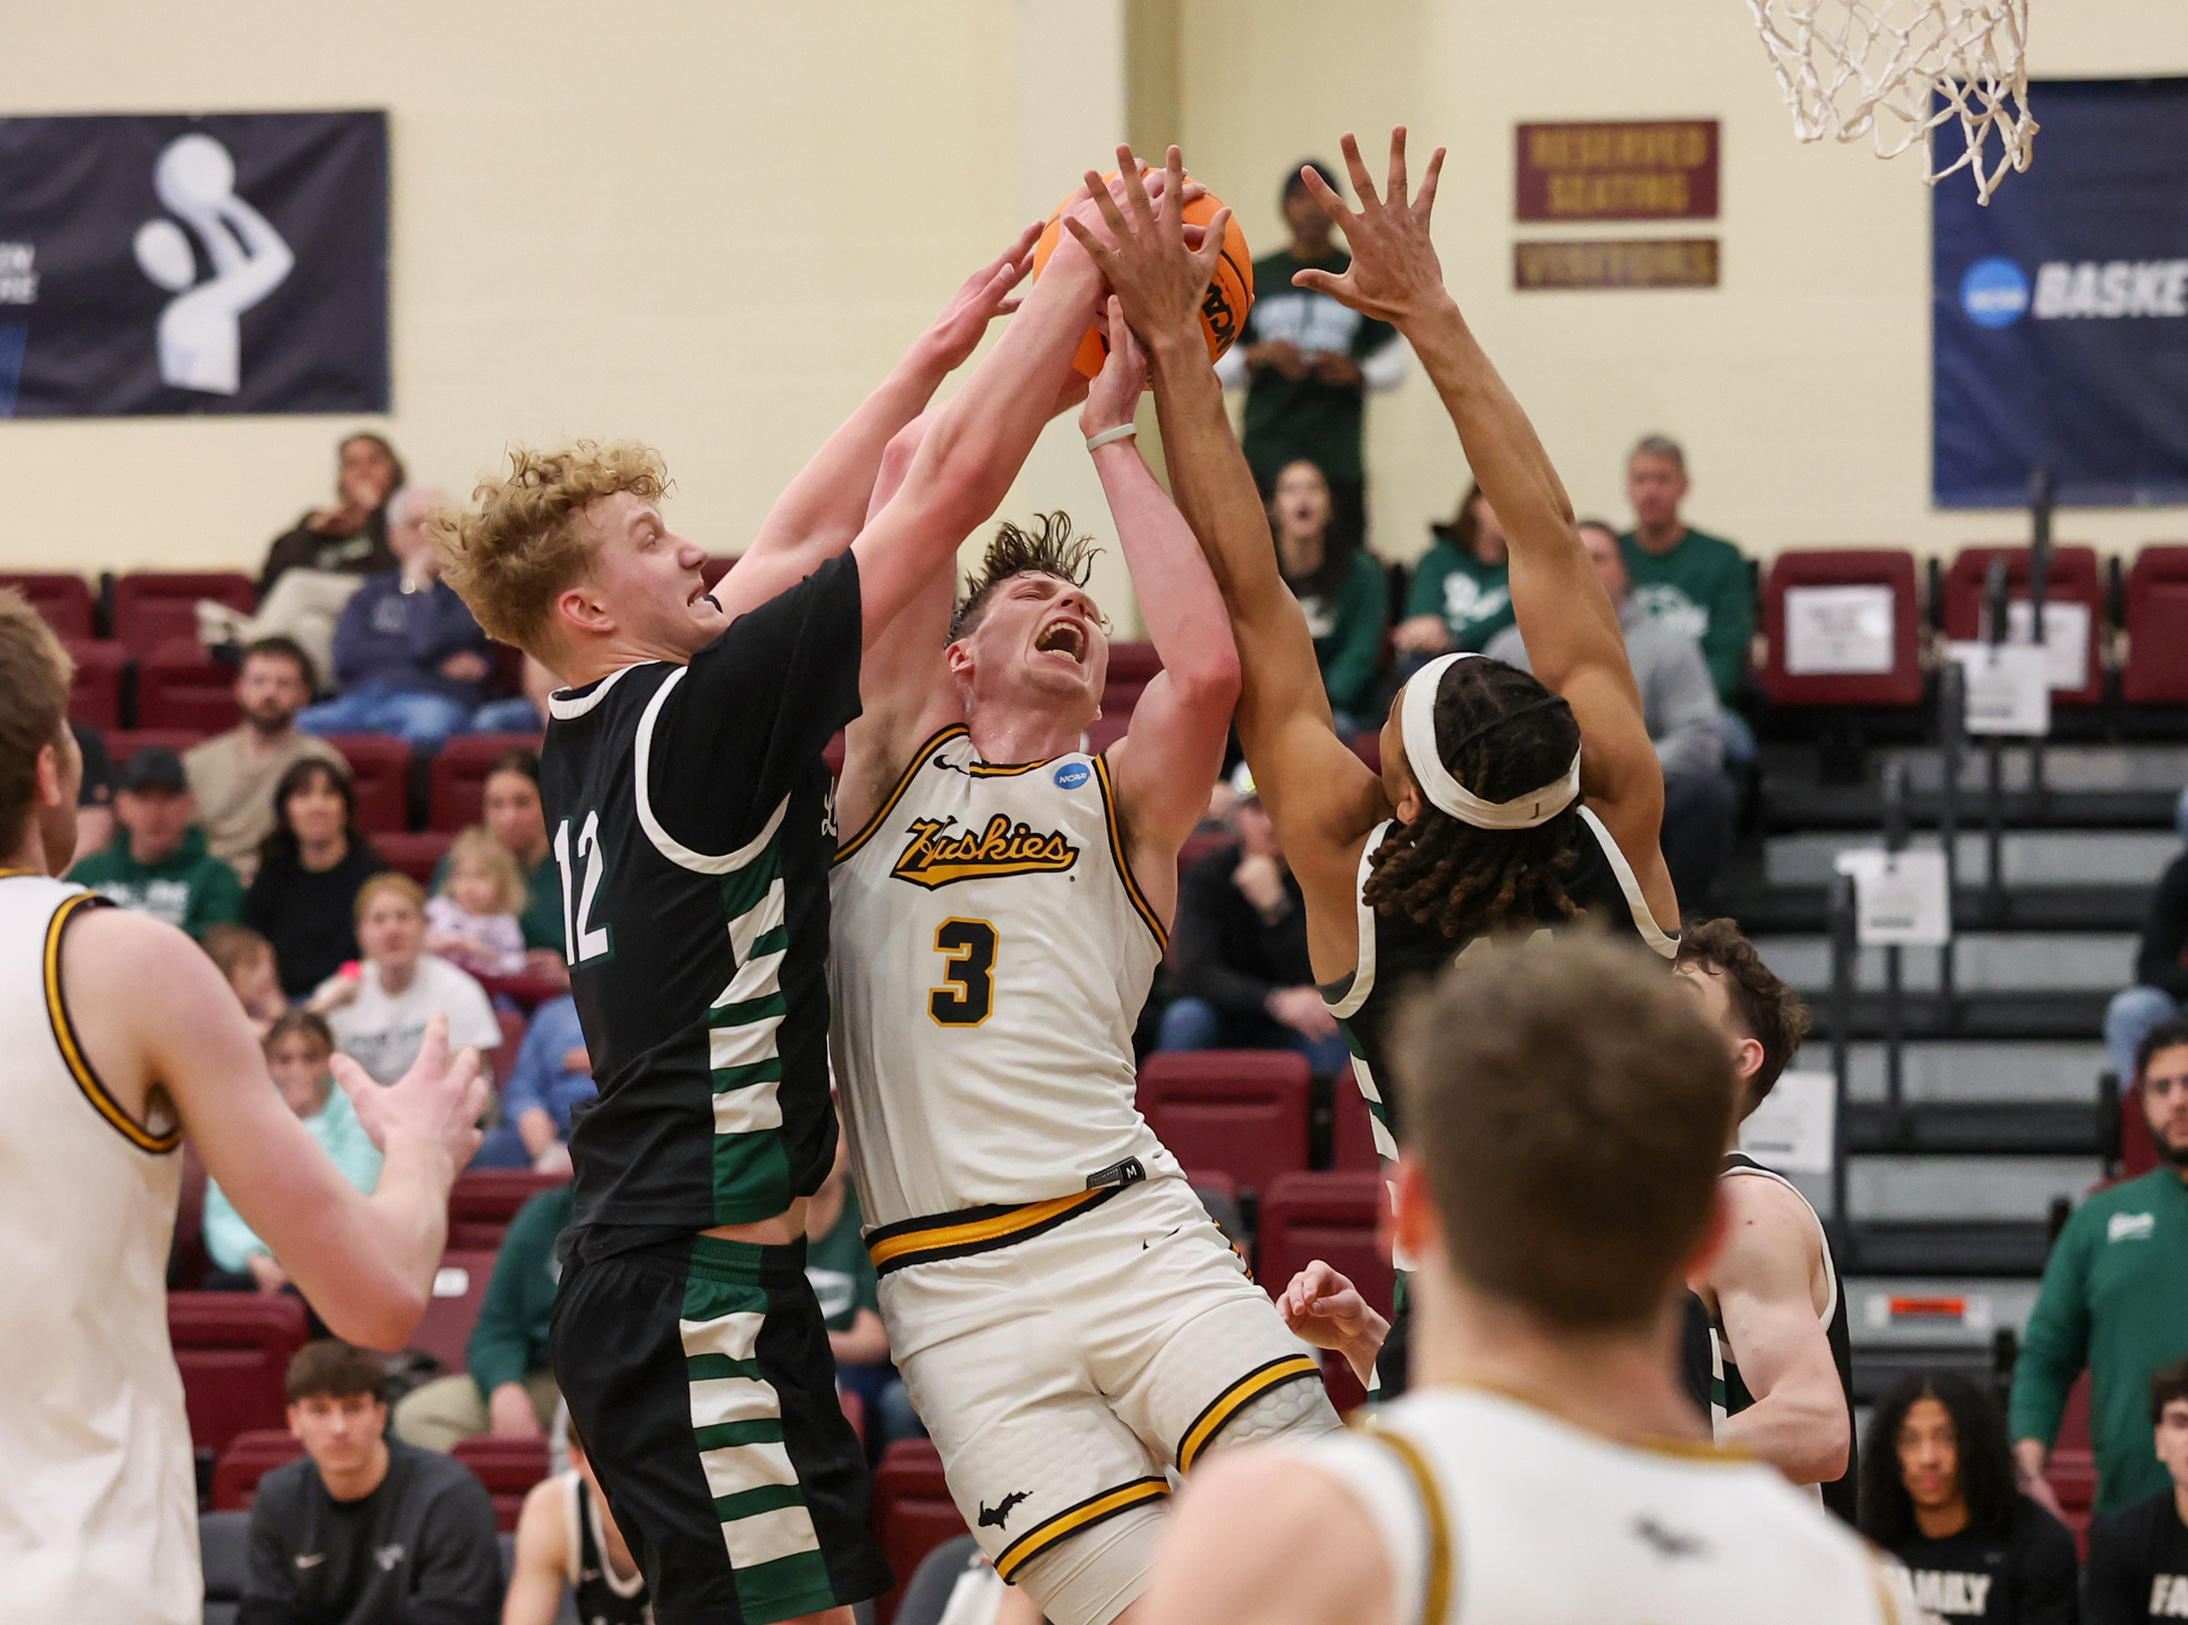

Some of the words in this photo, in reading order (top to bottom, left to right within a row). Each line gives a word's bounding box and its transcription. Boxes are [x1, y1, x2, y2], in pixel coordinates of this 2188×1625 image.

[2033, 259, 2188, 319] BASKE
[889, 813, 1080, 884] Huskies
[554, 811, 612, 968] 12
[927, 916, 999, 1027] 3
[1125, 1164, 1138, 1179] M
